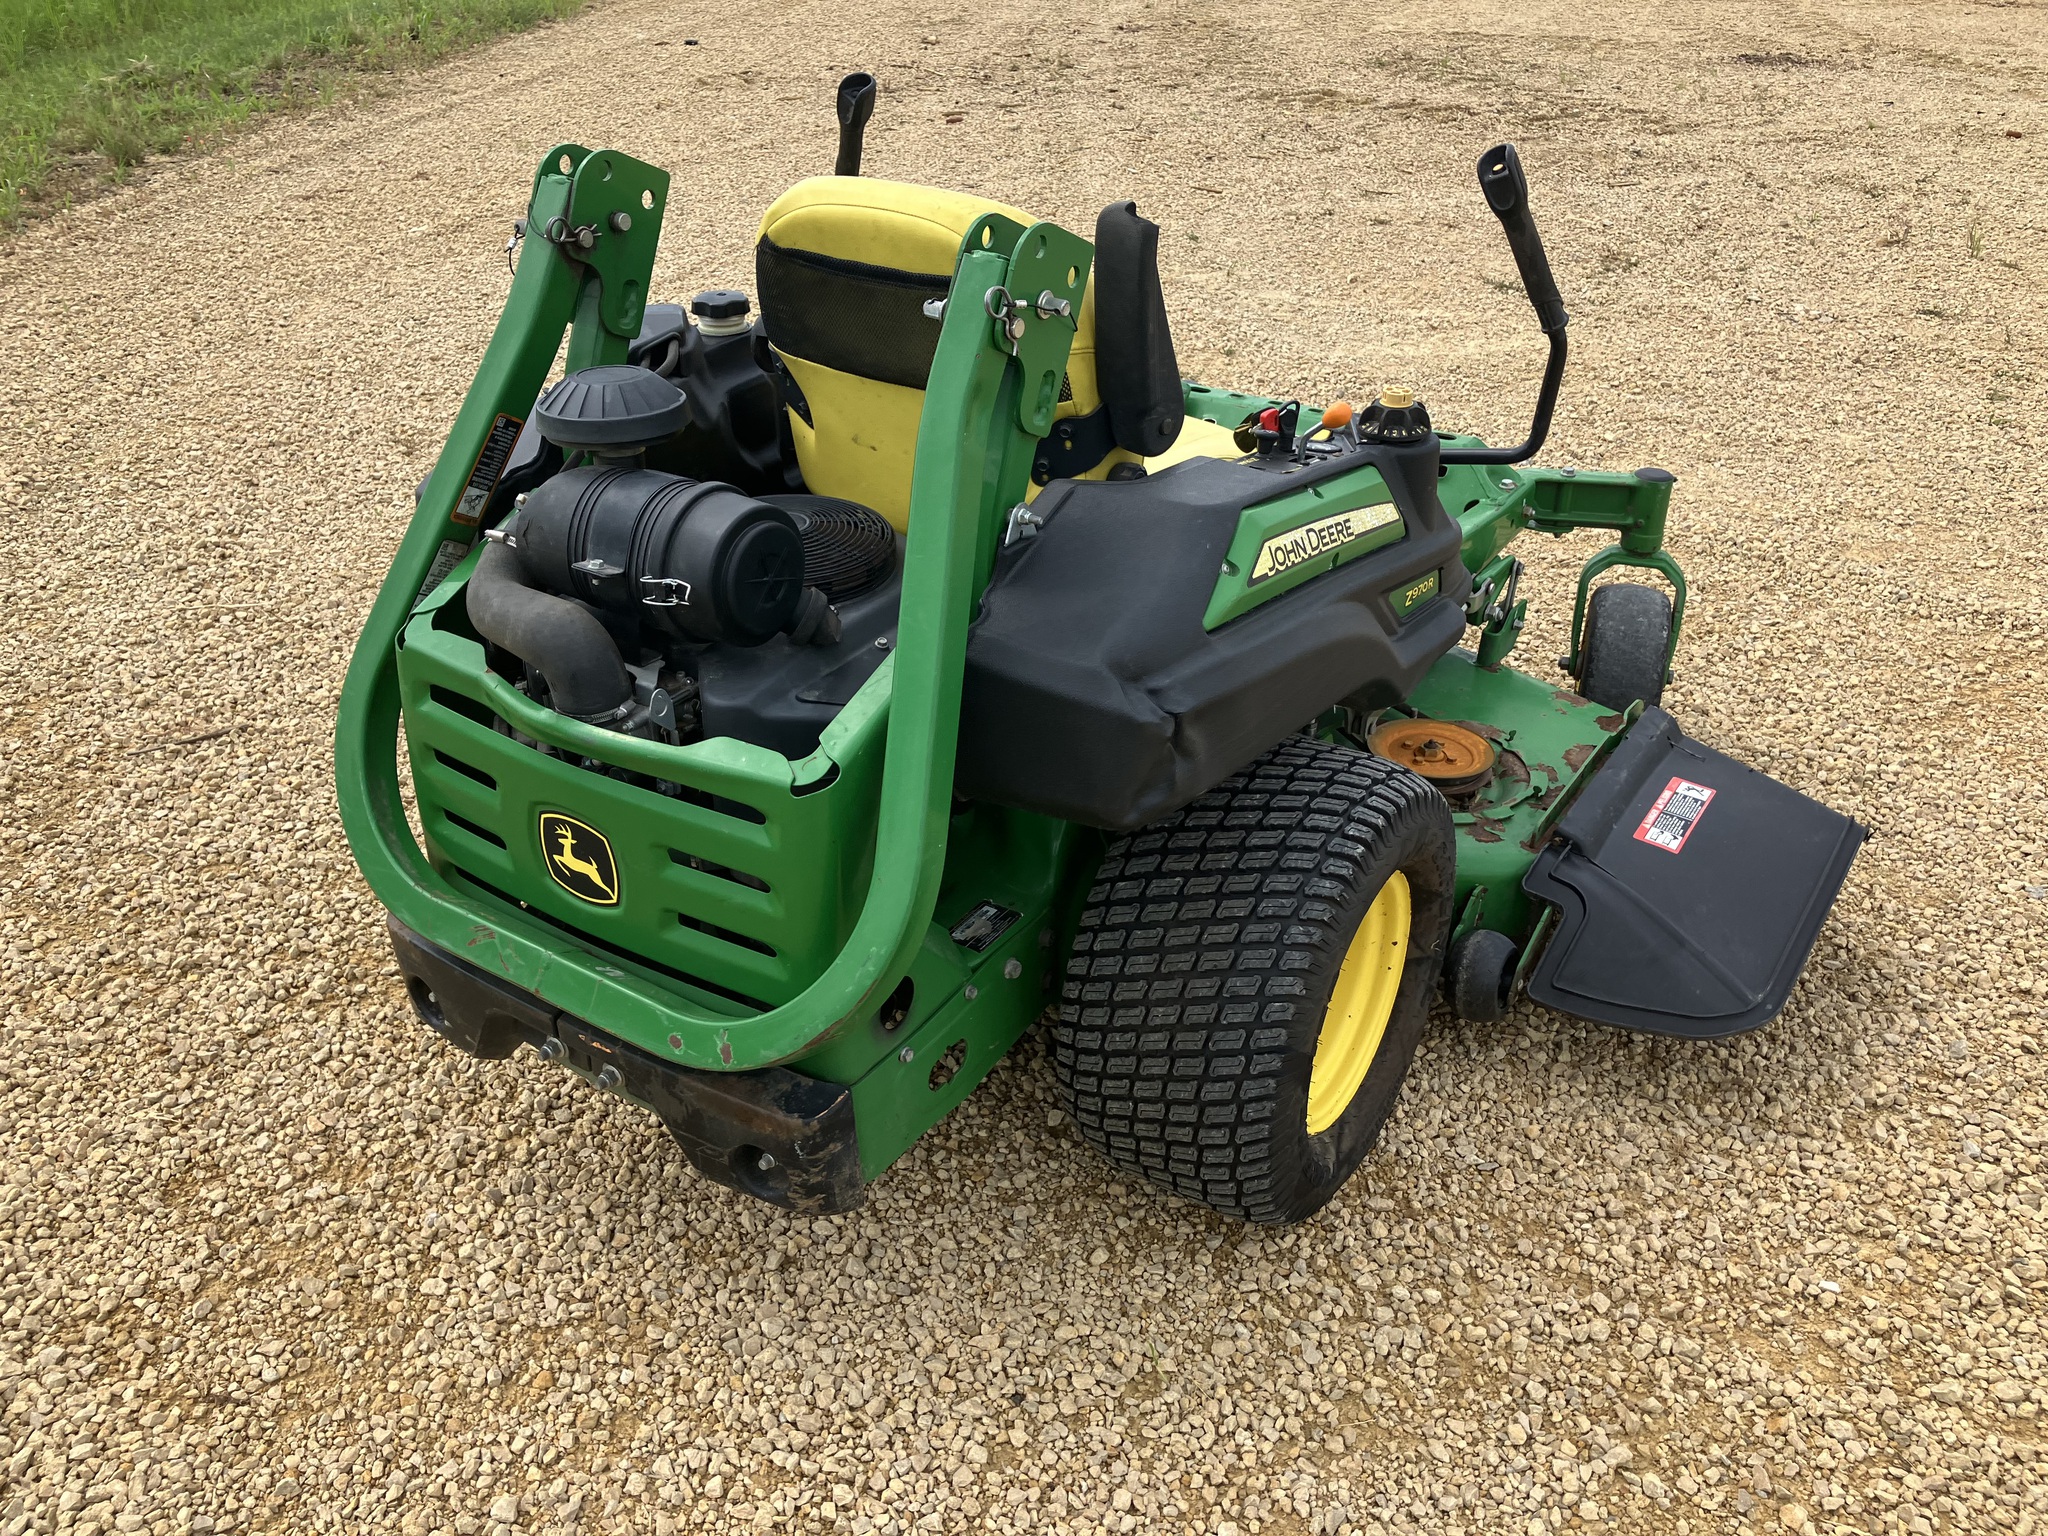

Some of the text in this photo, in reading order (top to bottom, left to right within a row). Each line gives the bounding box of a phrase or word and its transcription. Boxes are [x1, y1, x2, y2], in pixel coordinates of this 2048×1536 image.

[1267, 517, 1355, 573] JOHN DEERE
[1405, 576, 1434, 607] Z970R
